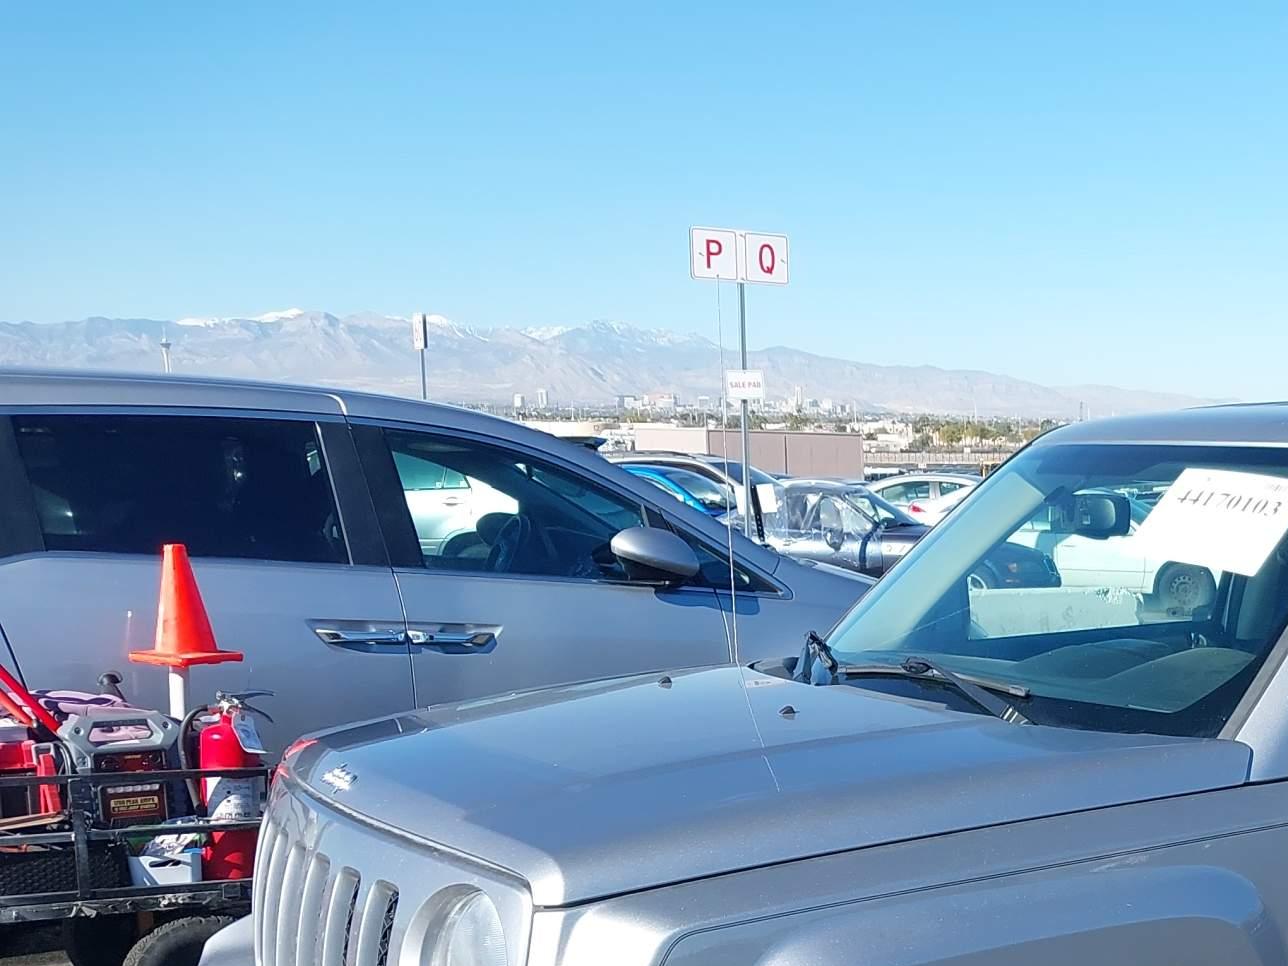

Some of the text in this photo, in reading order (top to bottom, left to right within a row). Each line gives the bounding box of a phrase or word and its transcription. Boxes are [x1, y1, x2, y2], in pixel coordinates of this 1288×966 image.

[705, 239, 775, 274] P Q
[1177, 488, 1283, 517] 44170103
